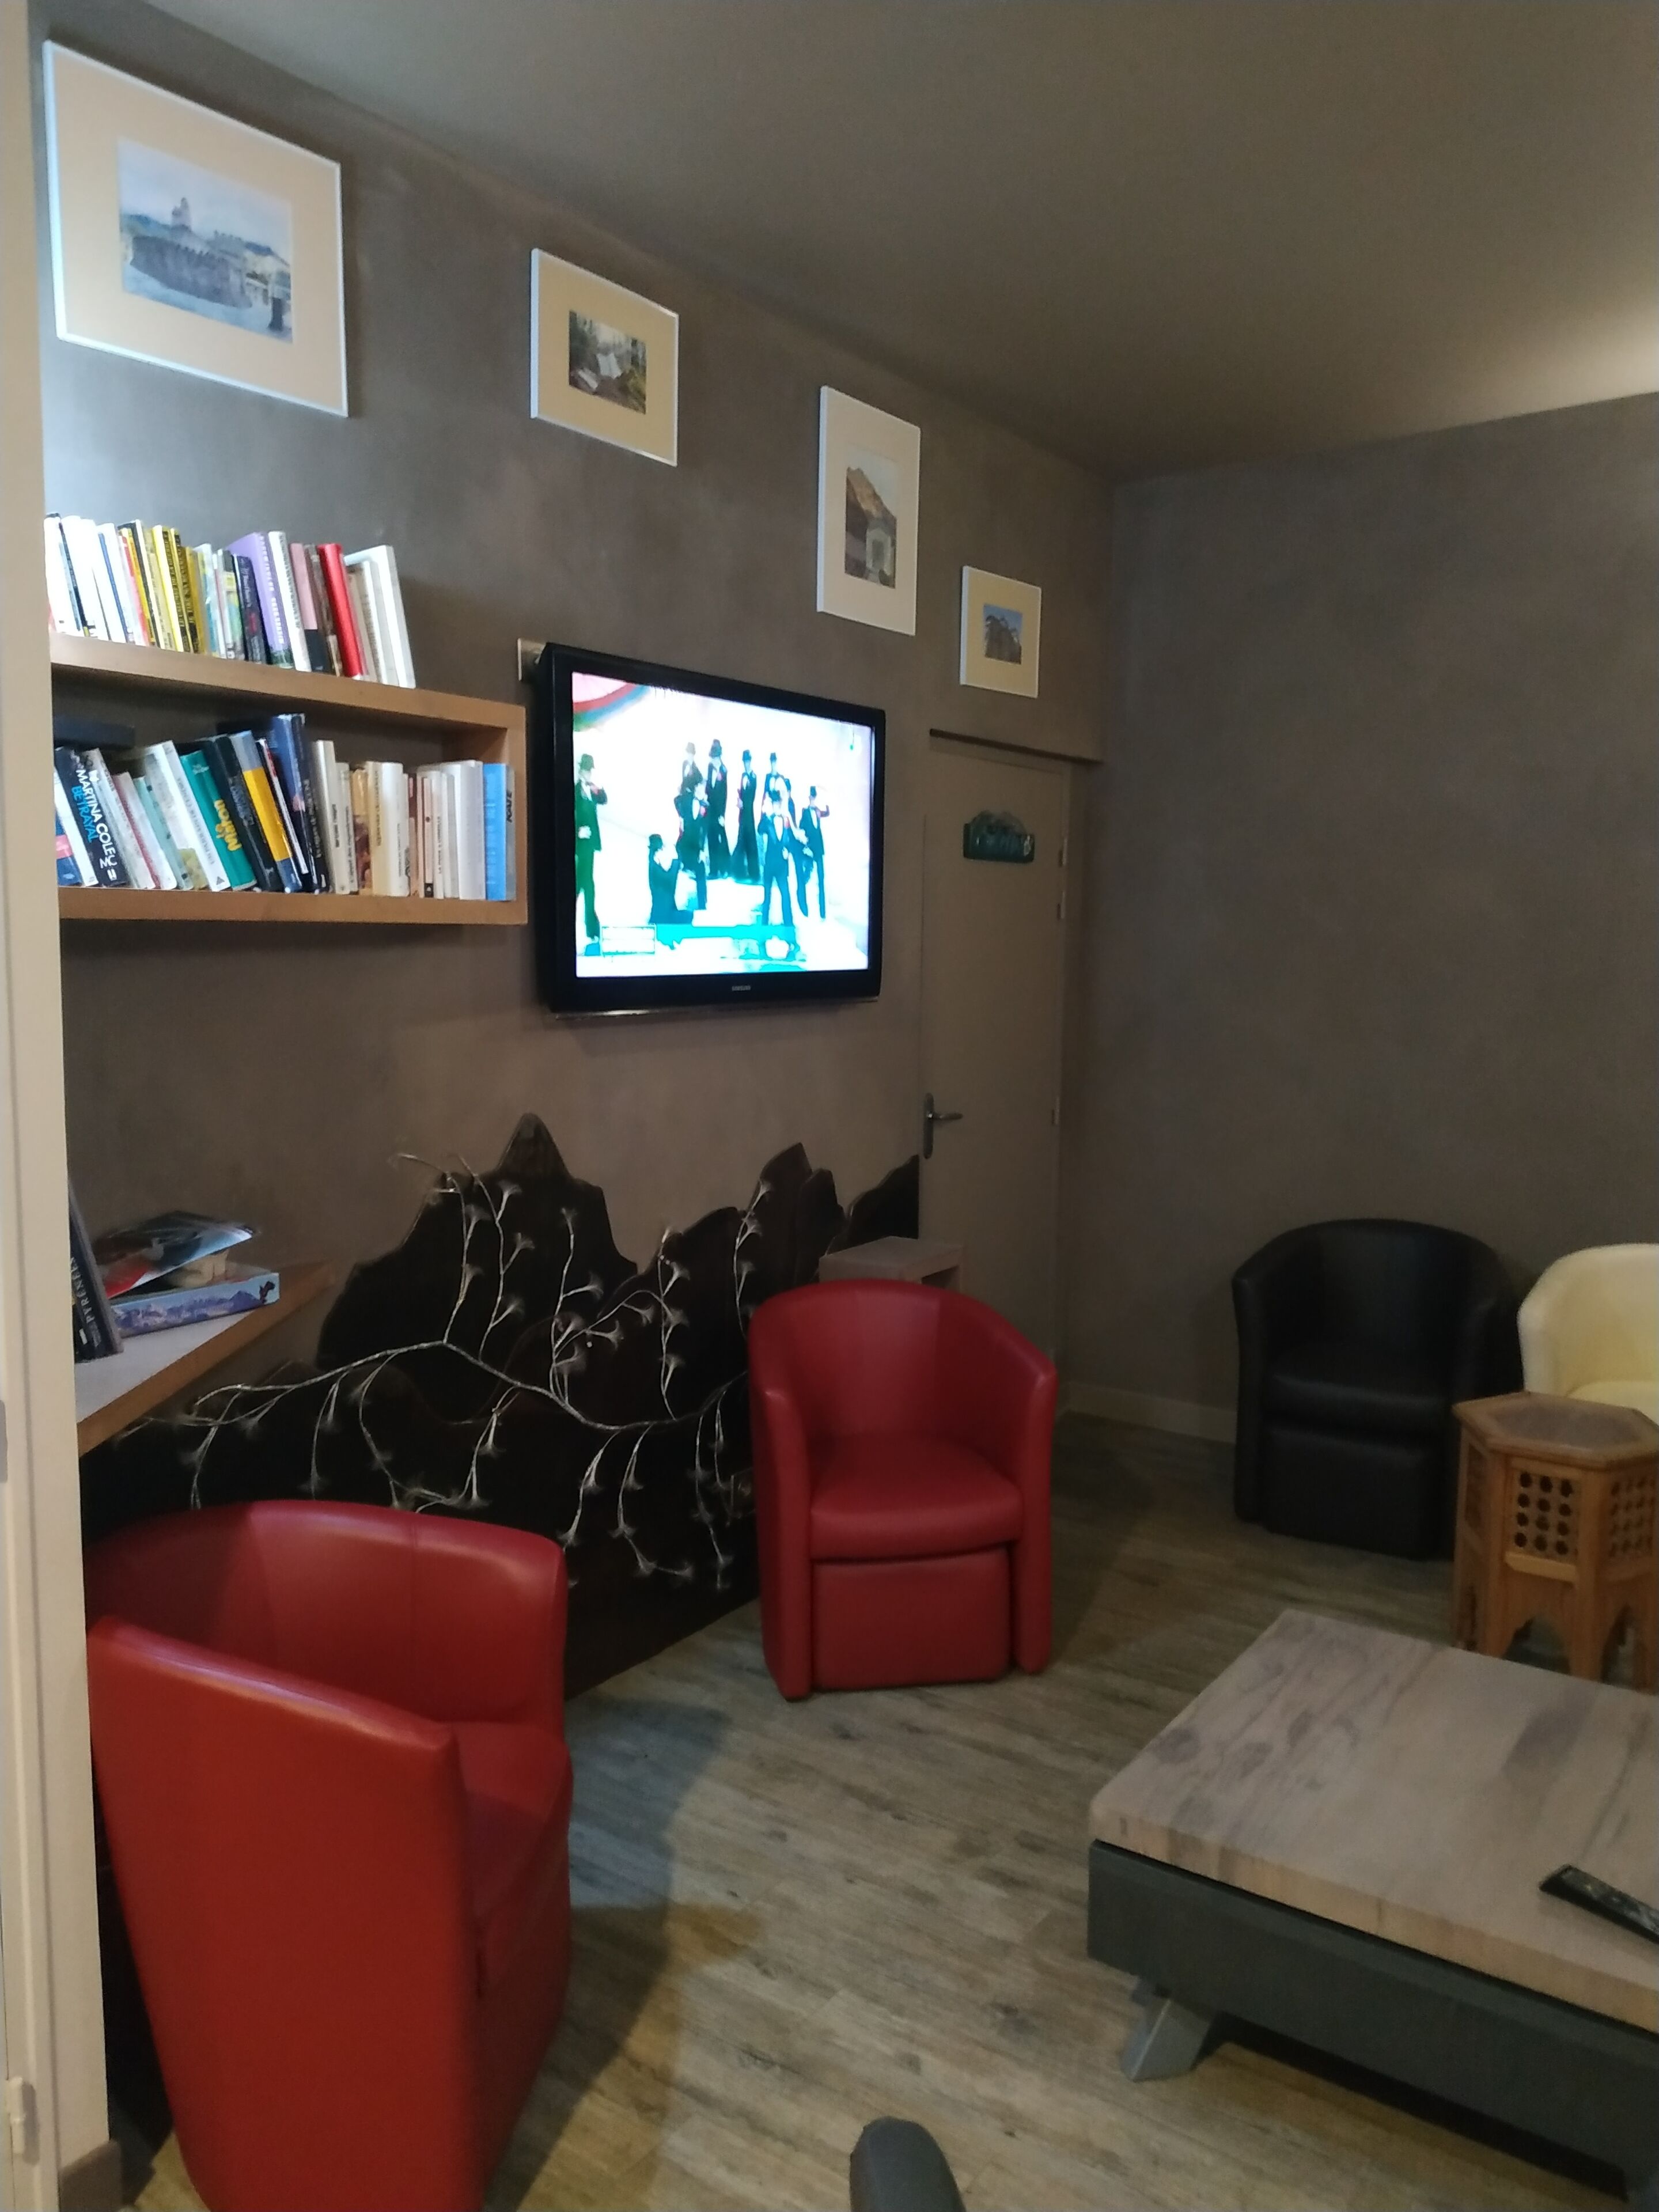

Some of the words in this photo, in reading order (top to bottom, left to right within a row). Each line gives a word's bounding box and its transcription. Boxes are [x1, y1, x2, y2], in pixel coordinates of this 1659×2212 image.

[71, 786, 99, 843] BETRAYAL
[76, 770, 103, 823] MARTINA
[96, 823, 116, 855] COLE
